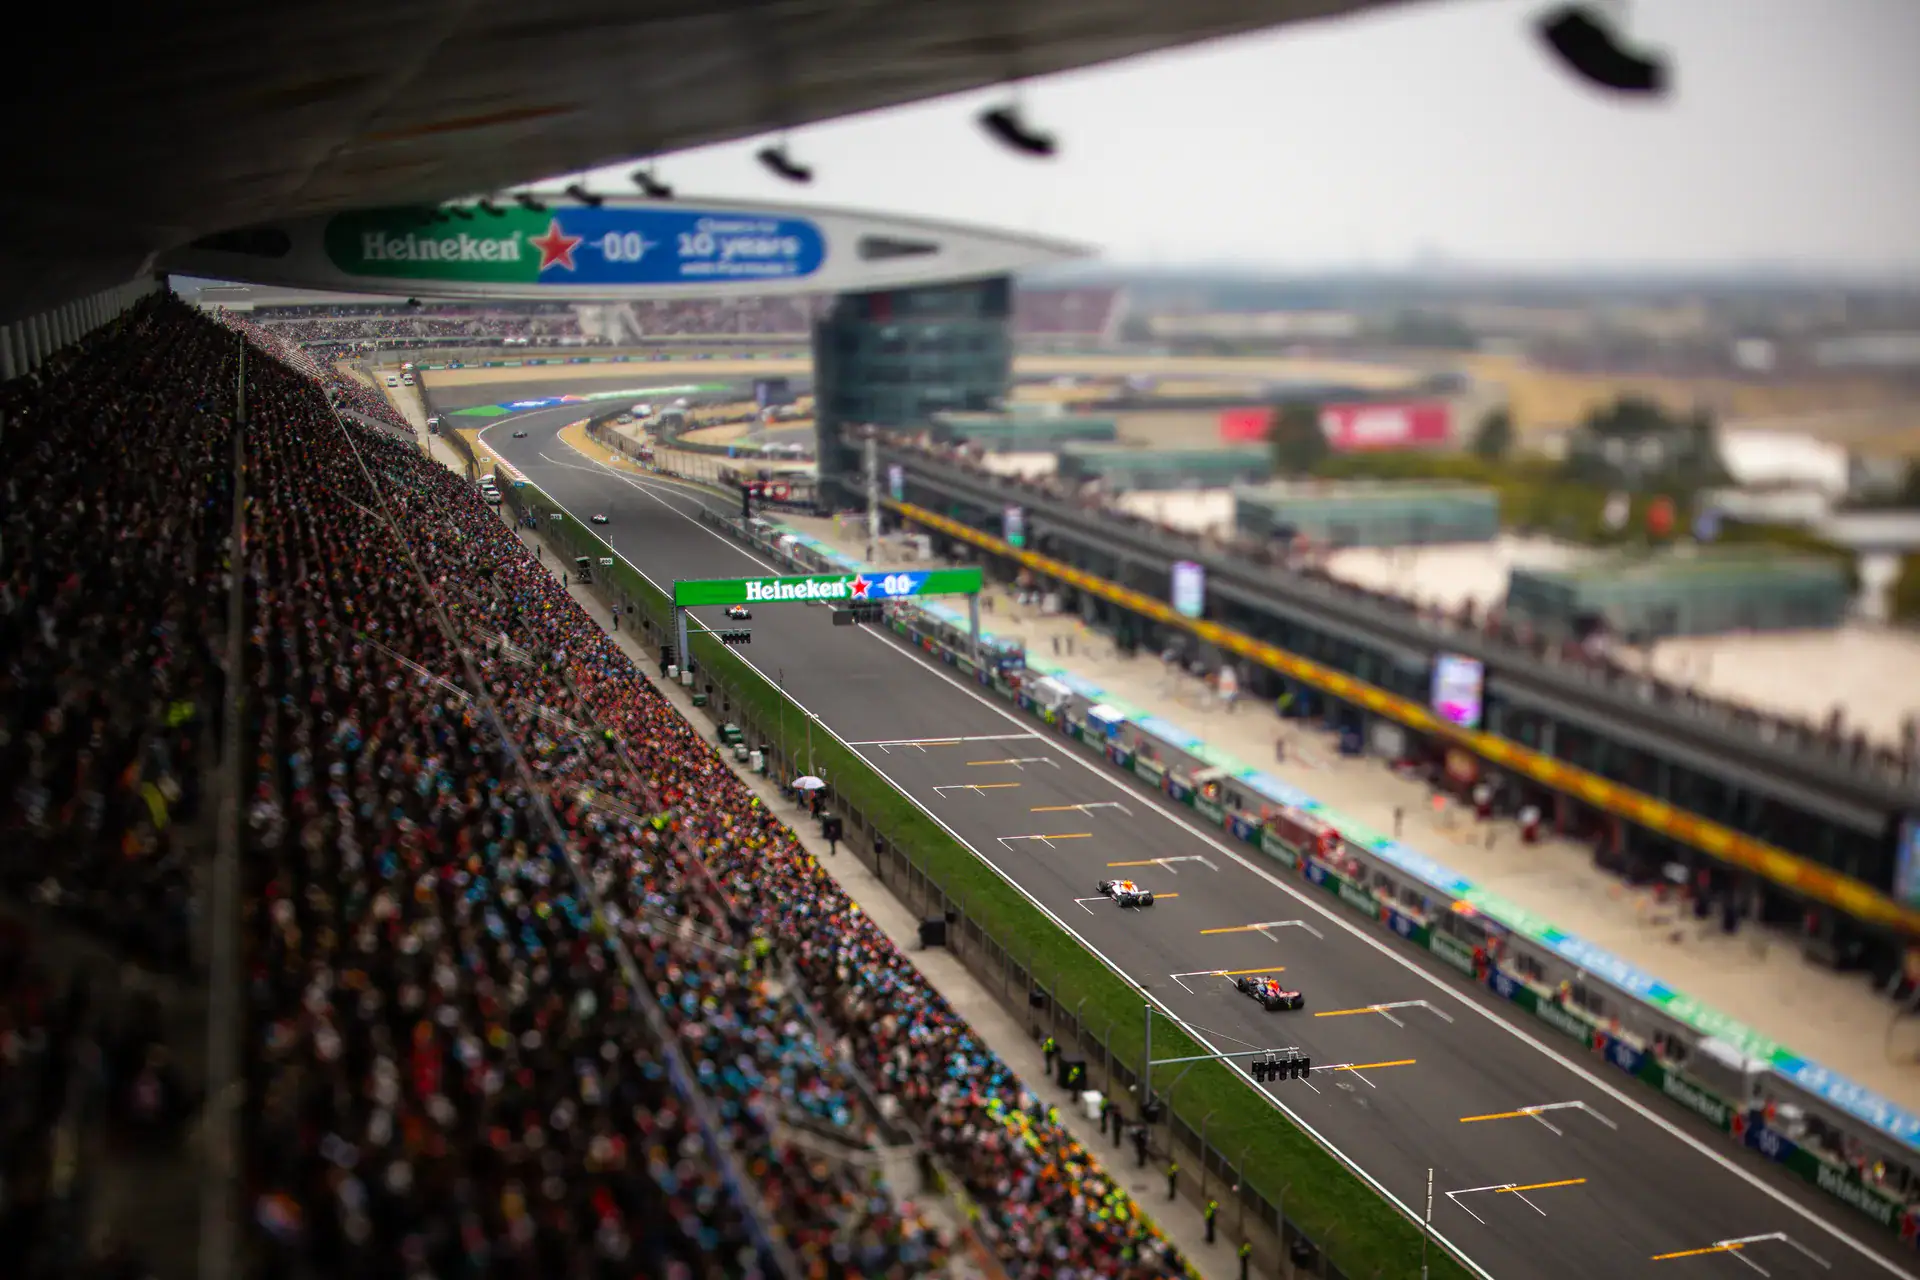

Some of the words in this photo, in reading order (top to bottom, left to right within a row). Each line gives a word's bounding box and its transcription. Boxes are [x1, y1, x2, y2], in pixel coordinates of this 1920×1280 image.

[363, 231, 521, 261] Heineken
[678, 231, 715, 256] 10
[746, 579, 846, 601] Heineken
